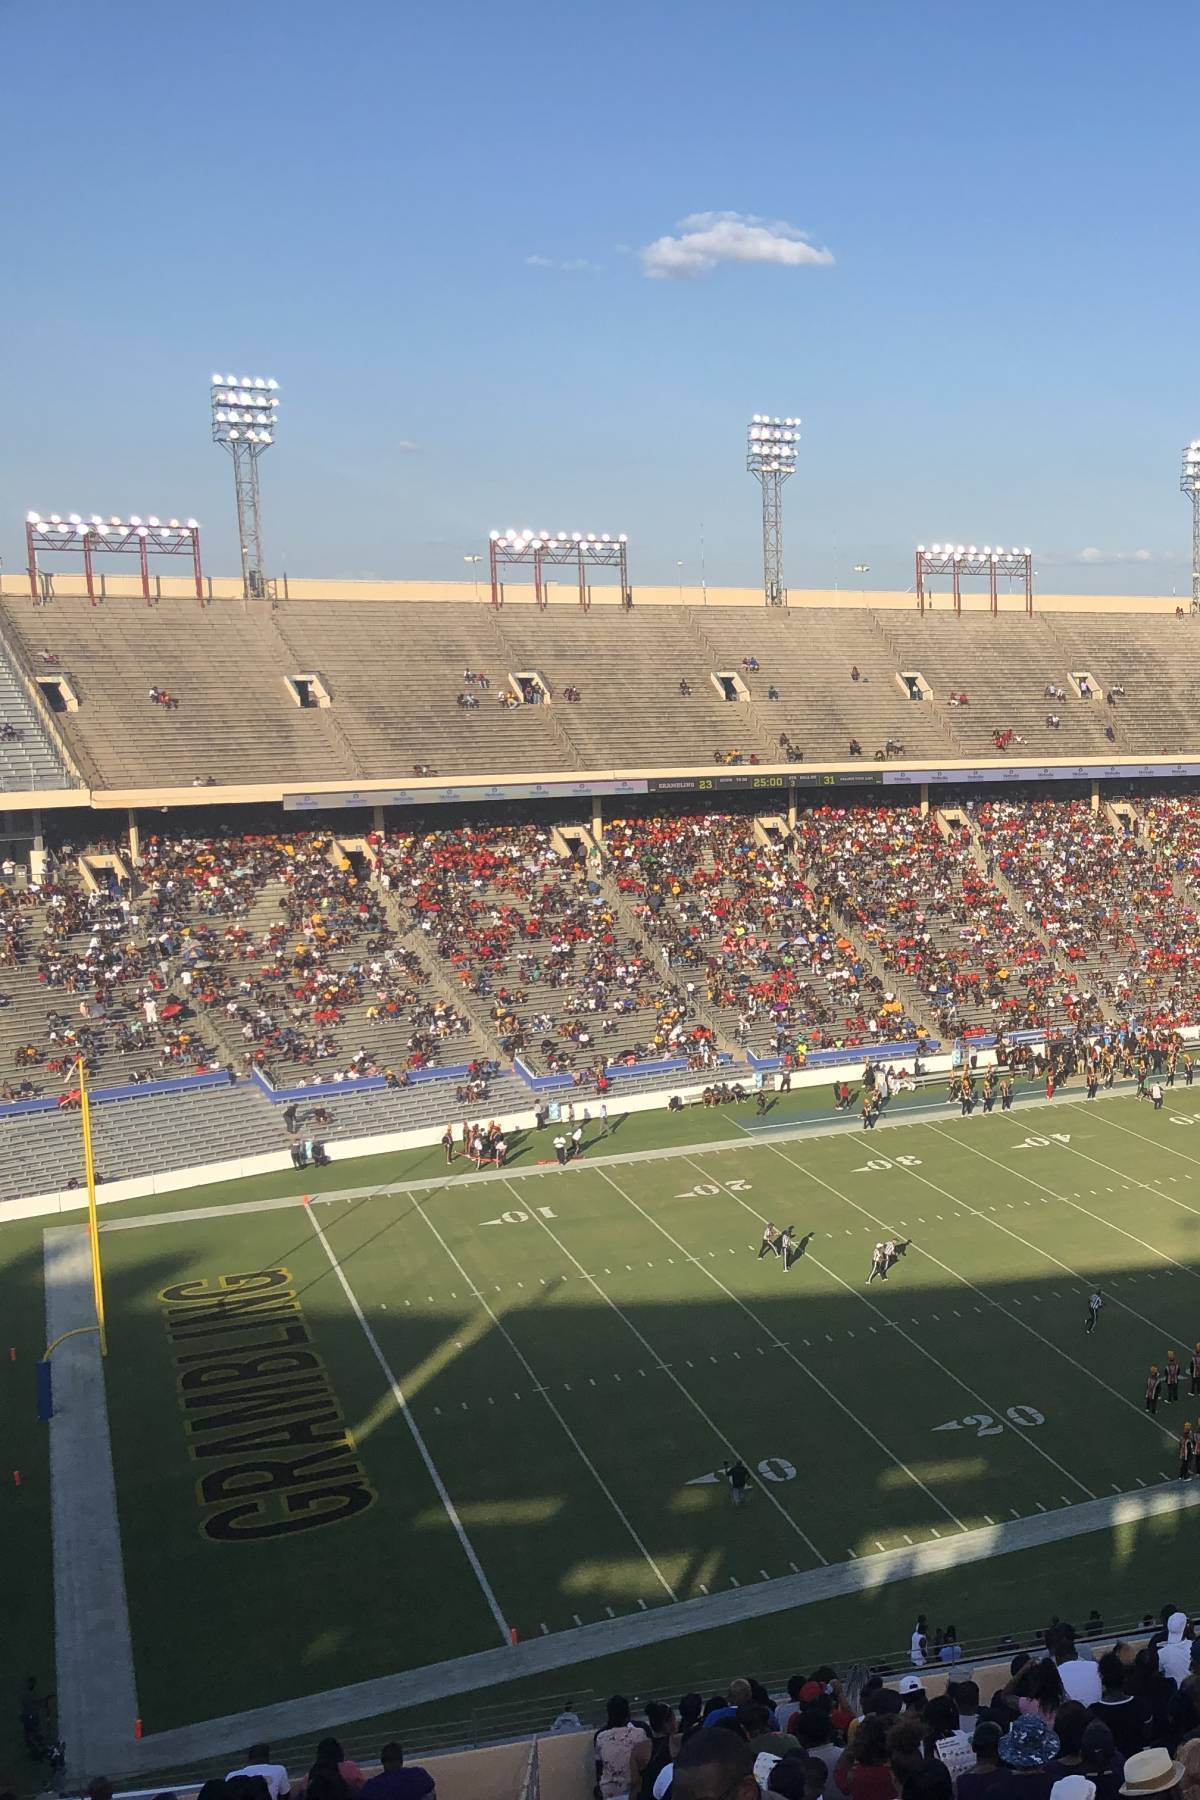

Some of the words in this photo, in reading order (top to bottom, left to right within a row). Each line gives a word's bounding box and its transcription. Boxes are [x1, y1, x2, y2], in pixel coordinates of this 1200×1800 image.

[699, 779, 713, 789] 23
[753, 777, 783, 788] 25:00
[823, 775, 836, 785] 31
[1024, 1132, 1071, 1149] 40
[866, 1154, 923, 1173] 30
[694, 1179, 752, 1197] 20
[502, 1206, 558, 1224] 10
[160, 1268, 377, 1542] GRAMBLING
[963, 1404, 1045, 1437] 20
